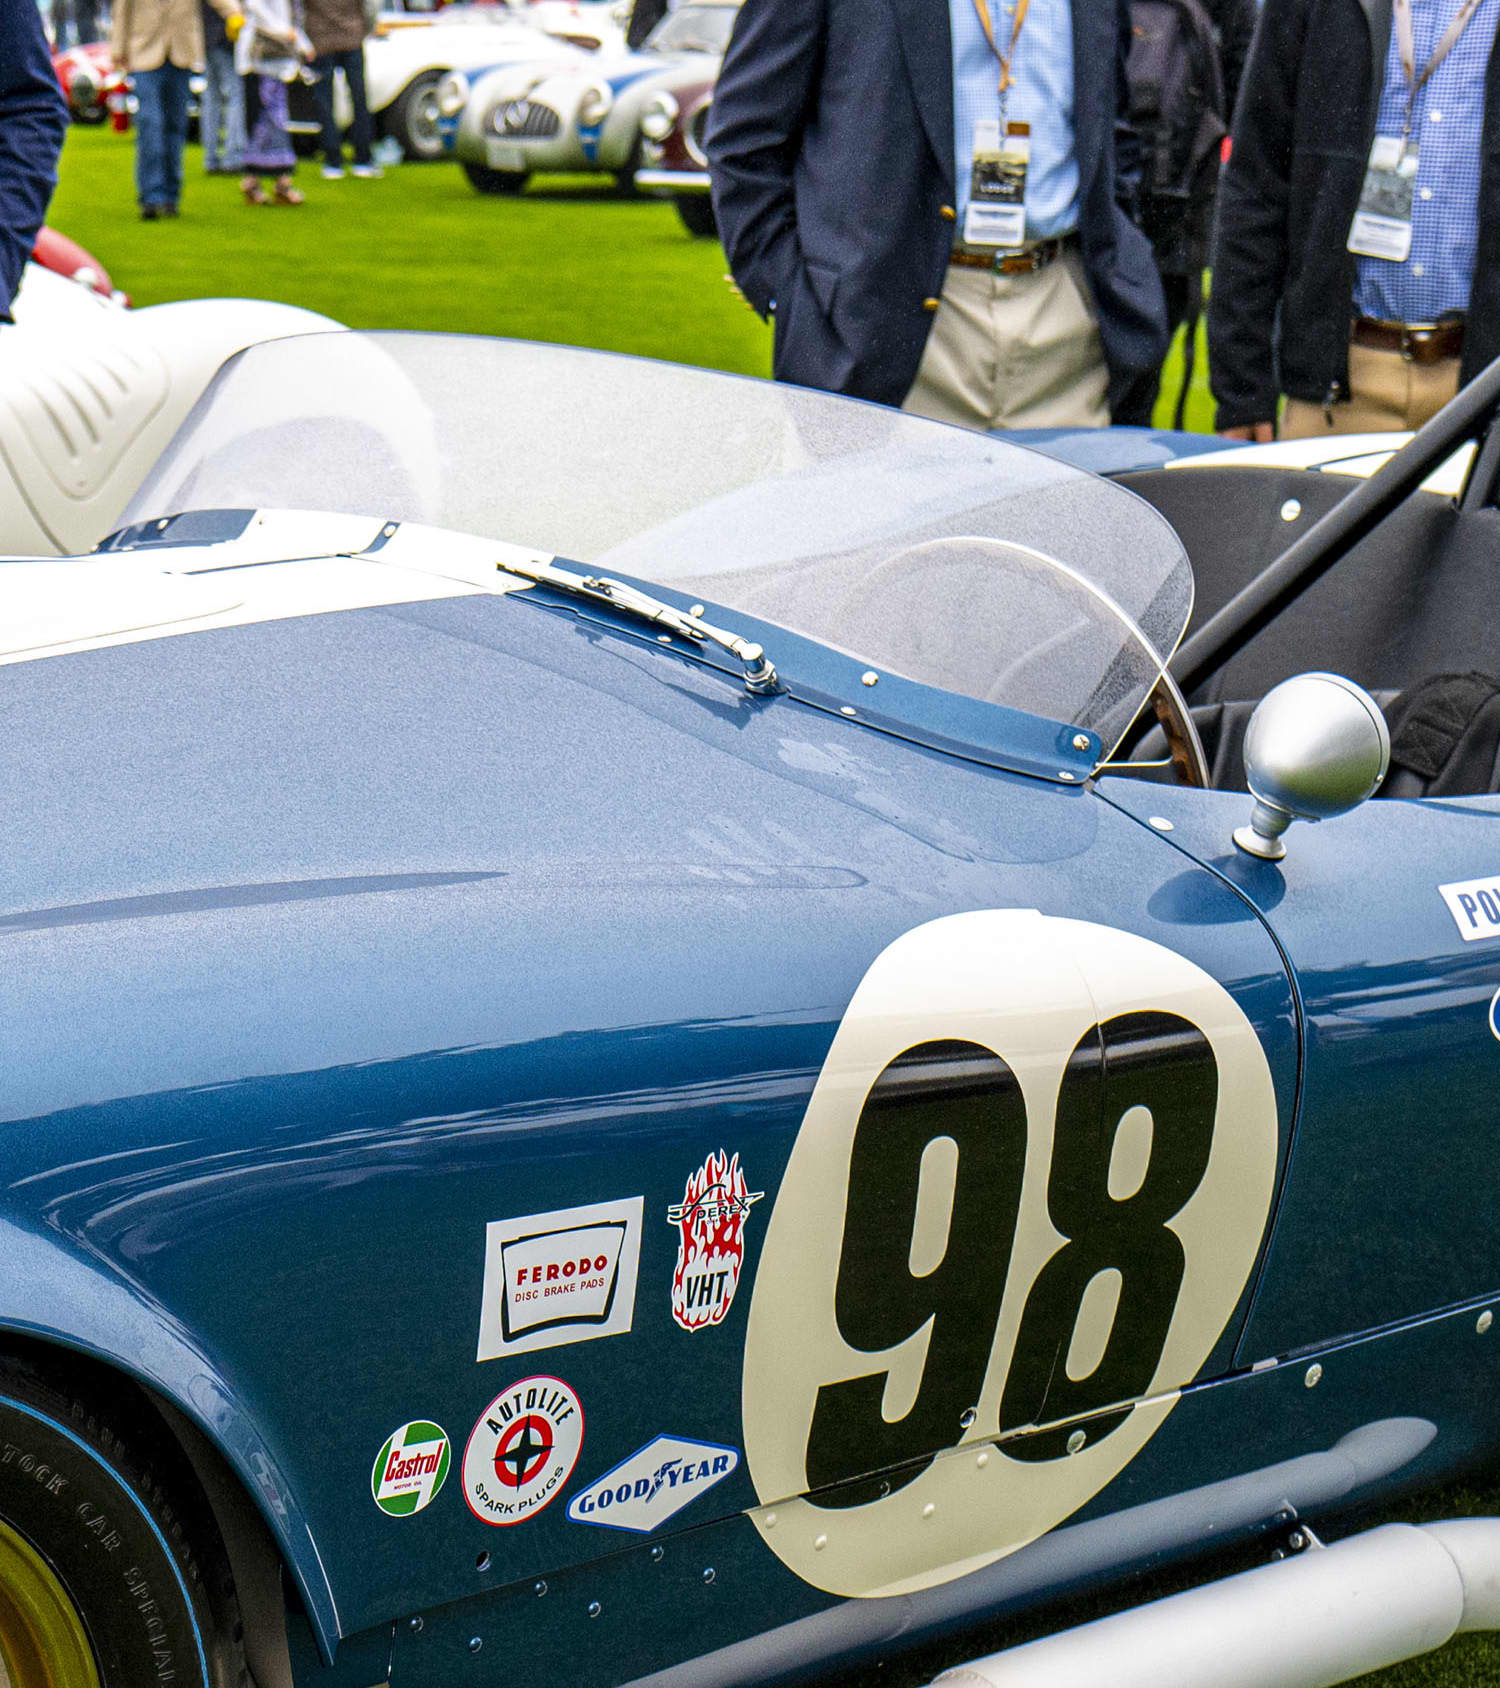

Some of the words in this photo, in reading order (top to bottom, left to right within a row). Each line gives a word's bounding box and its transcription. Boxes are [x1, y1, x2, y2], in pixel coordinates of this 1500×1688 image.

[516, 1254, 608, 1286] FERODO
[800, 1009, 1219, 1510] 98
[515, 1289, 539, 1303] DISC
[543, 1282, 576, 1298] BRAKE
[580, 1277, 605, 1290] PADS
[686, 1270, 729, 1309] VHT
[486, 1387, 575, 1436] AUTOLITE
[384, 1442, 443, 1482] Castrol
[475, 1482, 515, 1514] SPARK
[518, 1466, 564, 1512] PLUGS
[77, 1502, 122, 1552] CAR
[123, 1566, 176, 1681] SPECIAL
